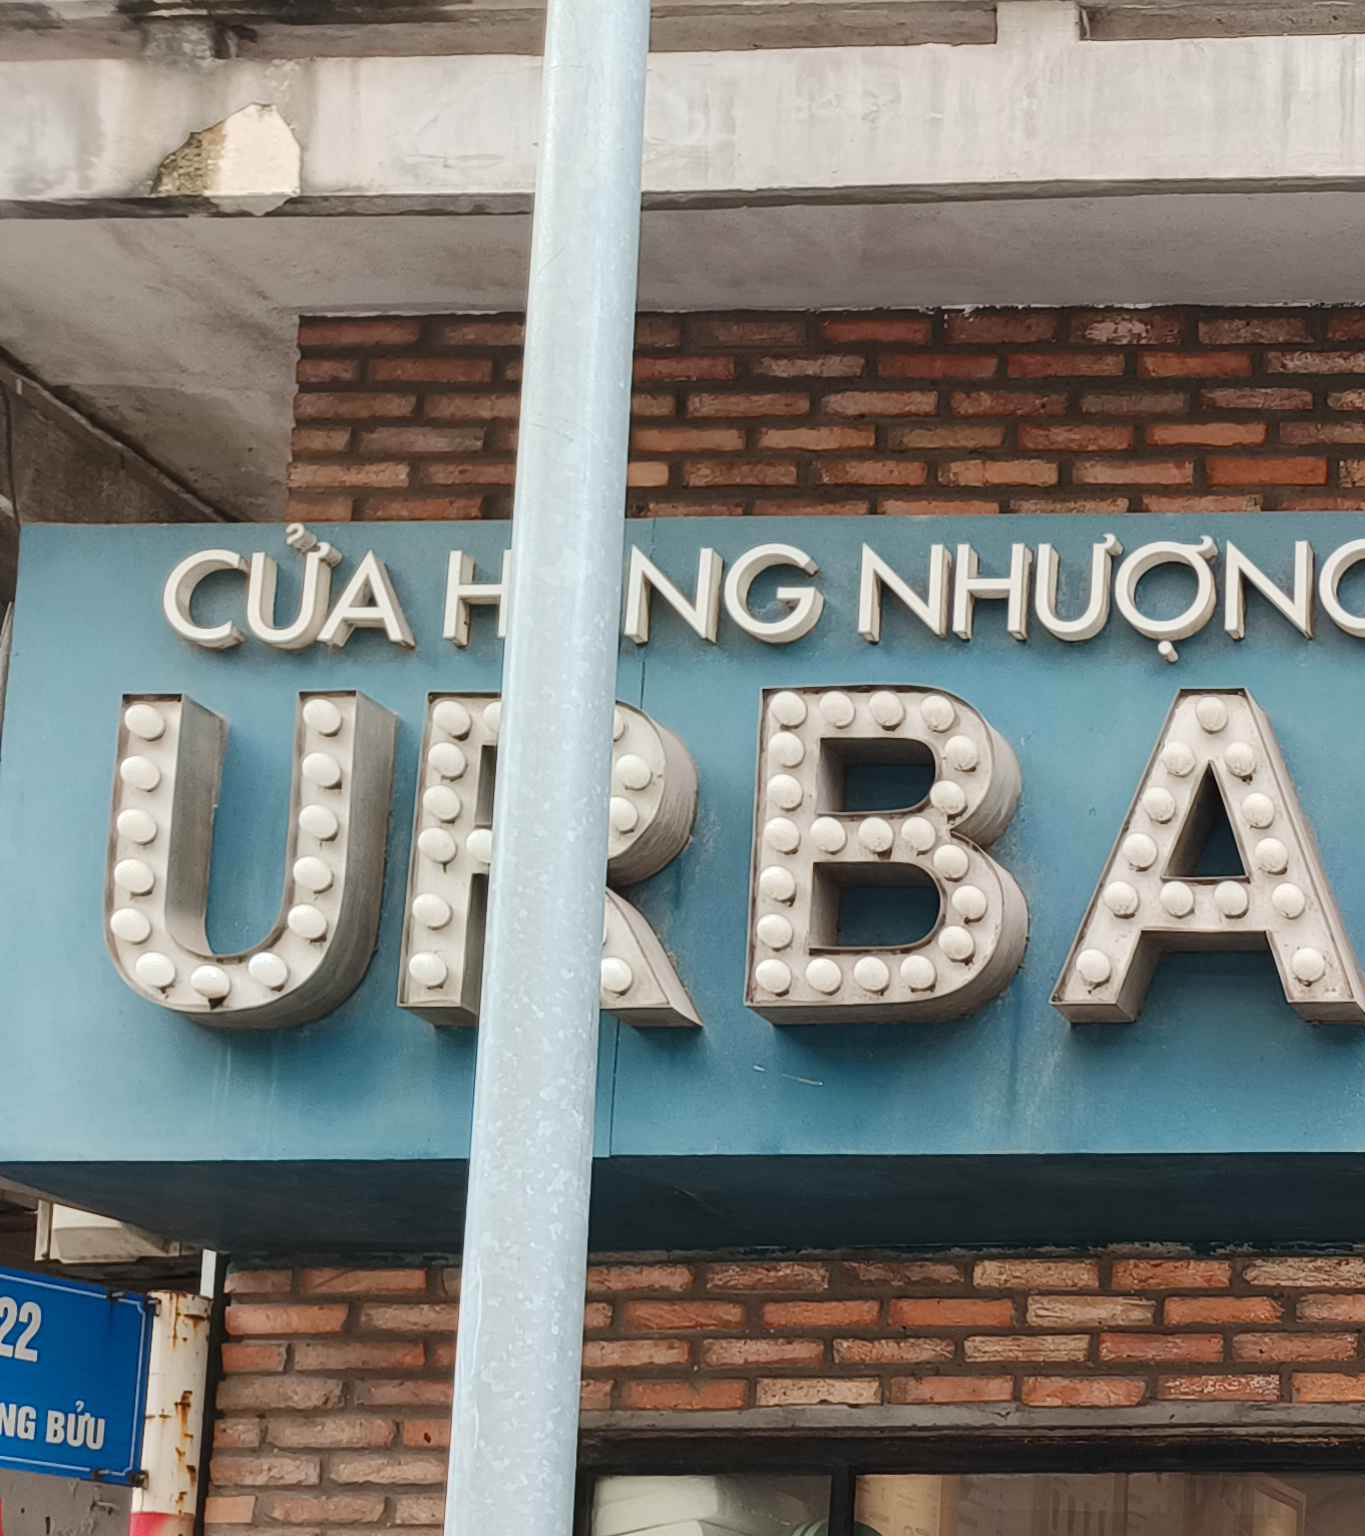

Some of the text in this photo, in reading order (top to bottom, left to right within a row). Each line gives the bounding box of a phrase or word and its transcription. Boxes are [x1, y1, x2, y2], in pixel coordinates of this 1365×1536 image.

[162, 523, 415, 649] CỬA
[442, 543, 824, 647] HNG
[45, 1400, 106, 1450] BỬU
